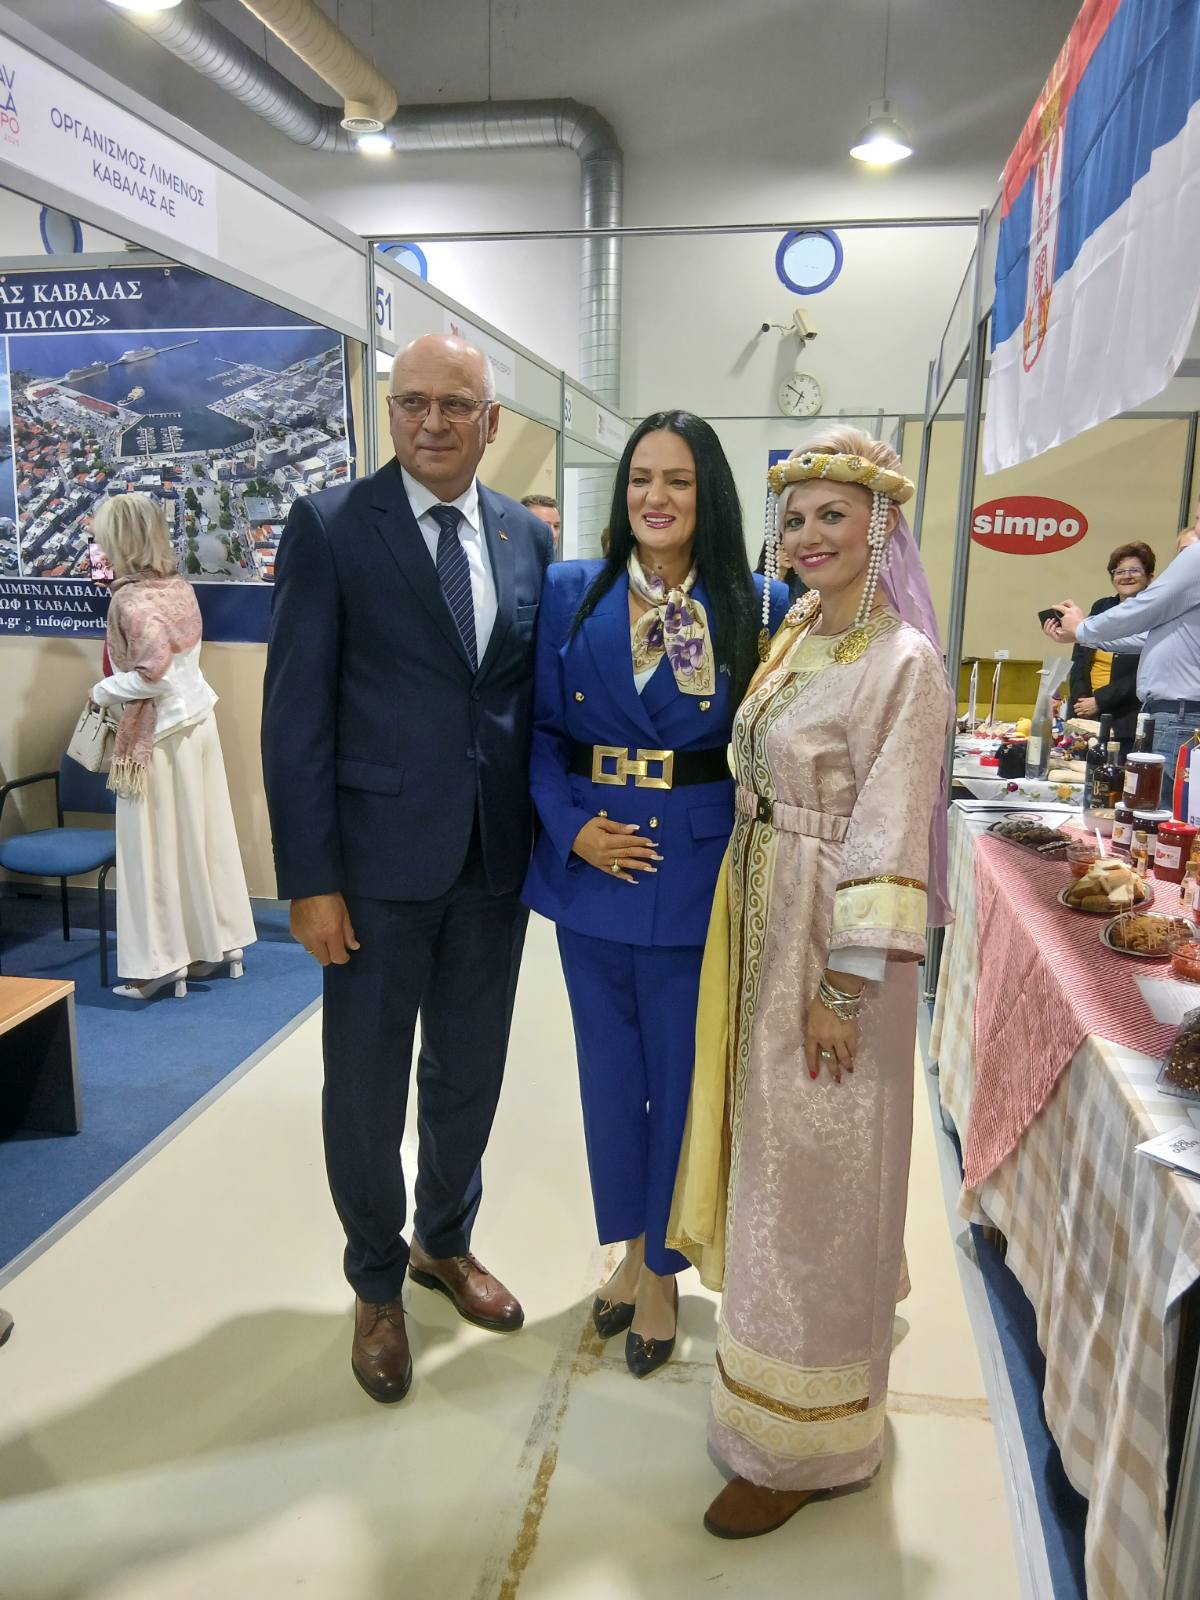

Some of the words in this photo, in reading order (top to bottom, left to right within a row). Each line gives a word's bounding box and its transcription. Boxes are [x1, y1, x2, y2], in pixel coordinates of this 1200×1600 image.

[51, 107, 147, 175] ΟΡΓΑΝΙΣΜΟΣ
[150, 163, 204, 207] ΛΙΜΕΝΟΣ
[93, 159, 156, 208] ΚΑΒΑΛΑΣ
[160, 196, 176, 218] ΑΕ
[32, 281, 143, 303] ΚΑΒΑΛΑΣ
[376, 286, 391, 330] 51
[5, 308, 111, 329] ΠΑΥΛΟΣ»
[973, 509, 1080, 541] simpo
[34, 600, 93, 612] ΚΑΒΑΛΑ
